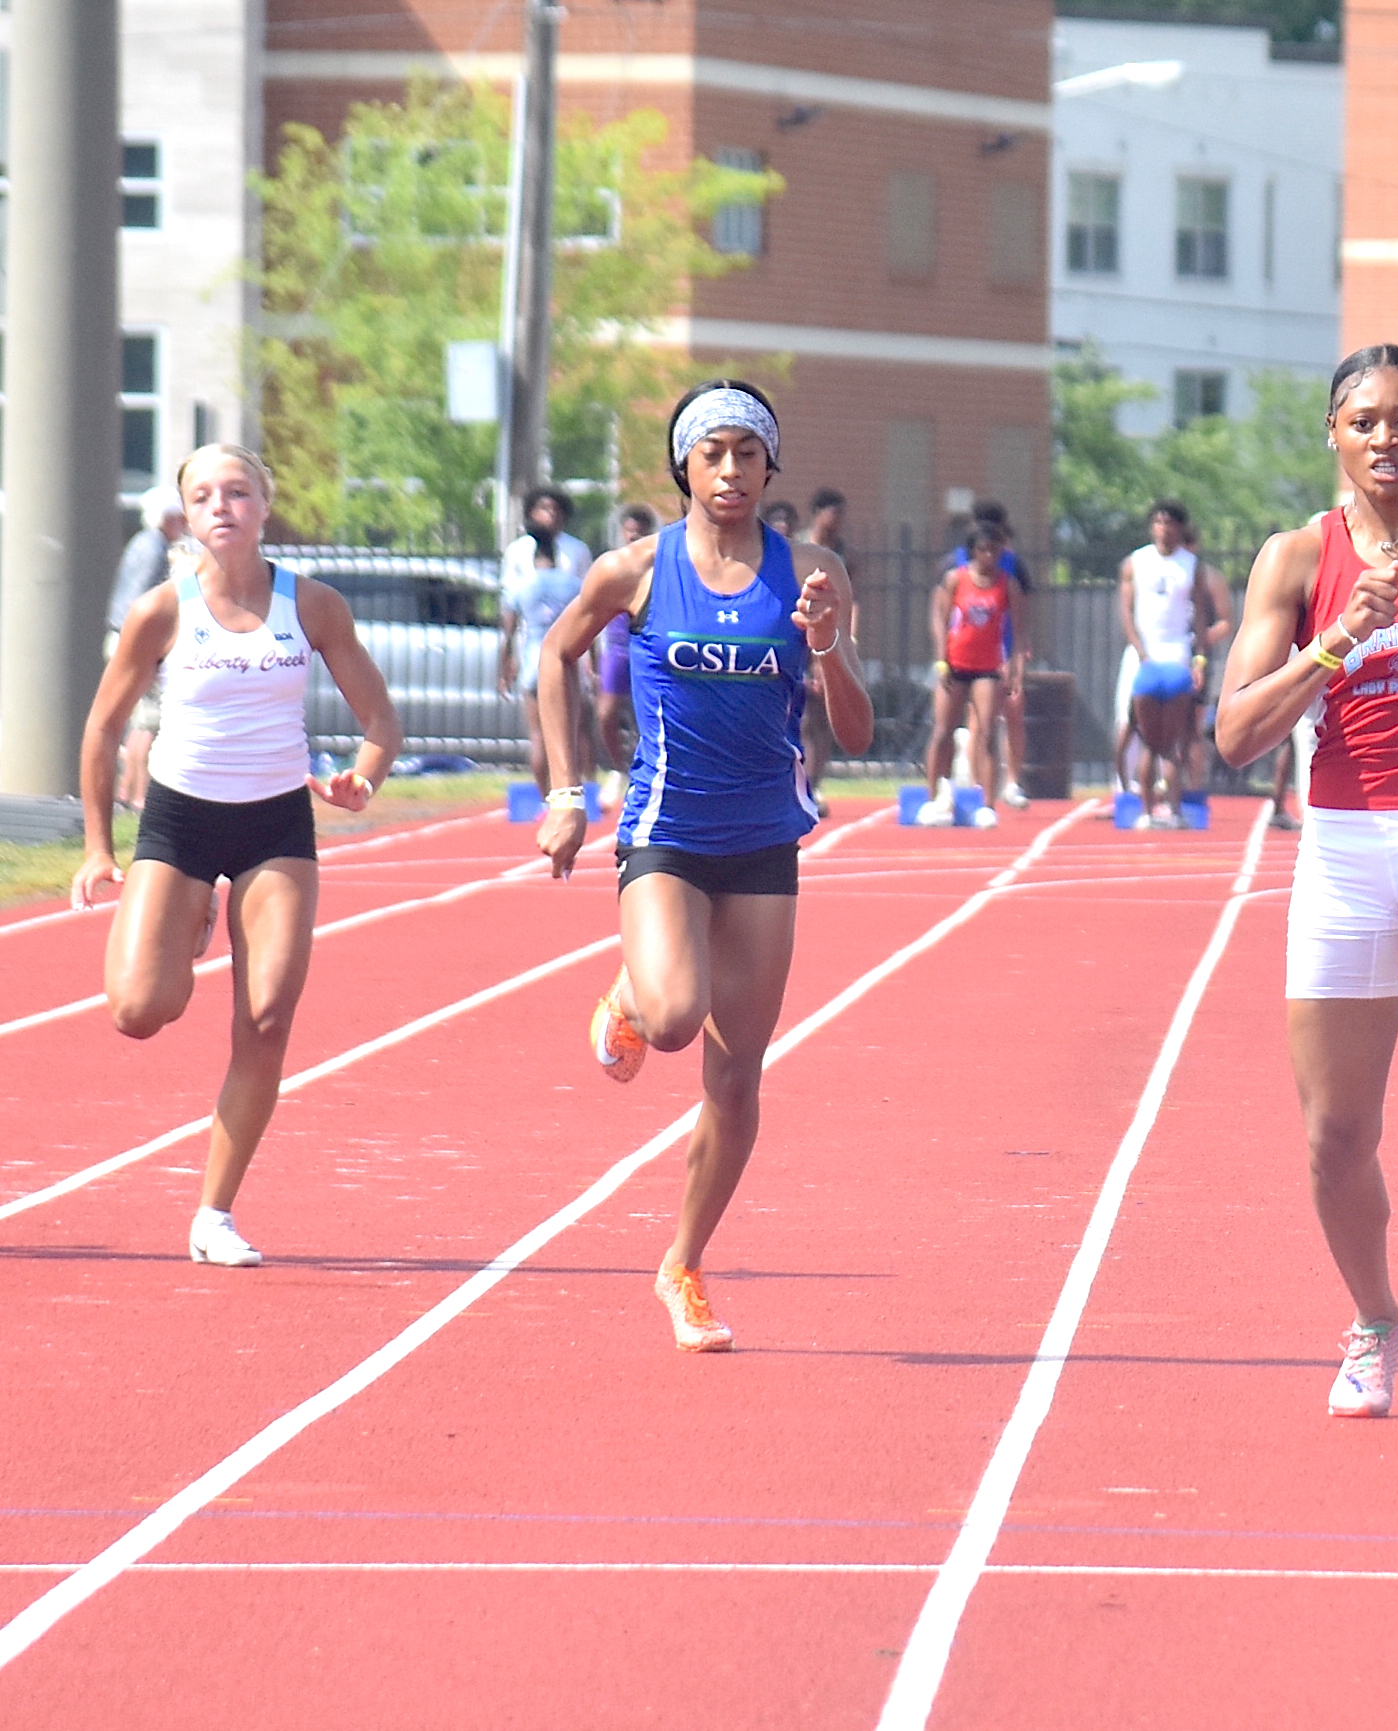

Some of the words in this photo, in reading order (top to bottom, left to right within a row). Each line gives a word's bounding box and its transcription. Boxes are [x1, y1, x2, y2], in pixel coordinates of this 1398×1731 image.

[183, 652, 251, 674] Liberty
[260, 650, 306, 672] Creek
[667, 641, 780, 674] CSLA
